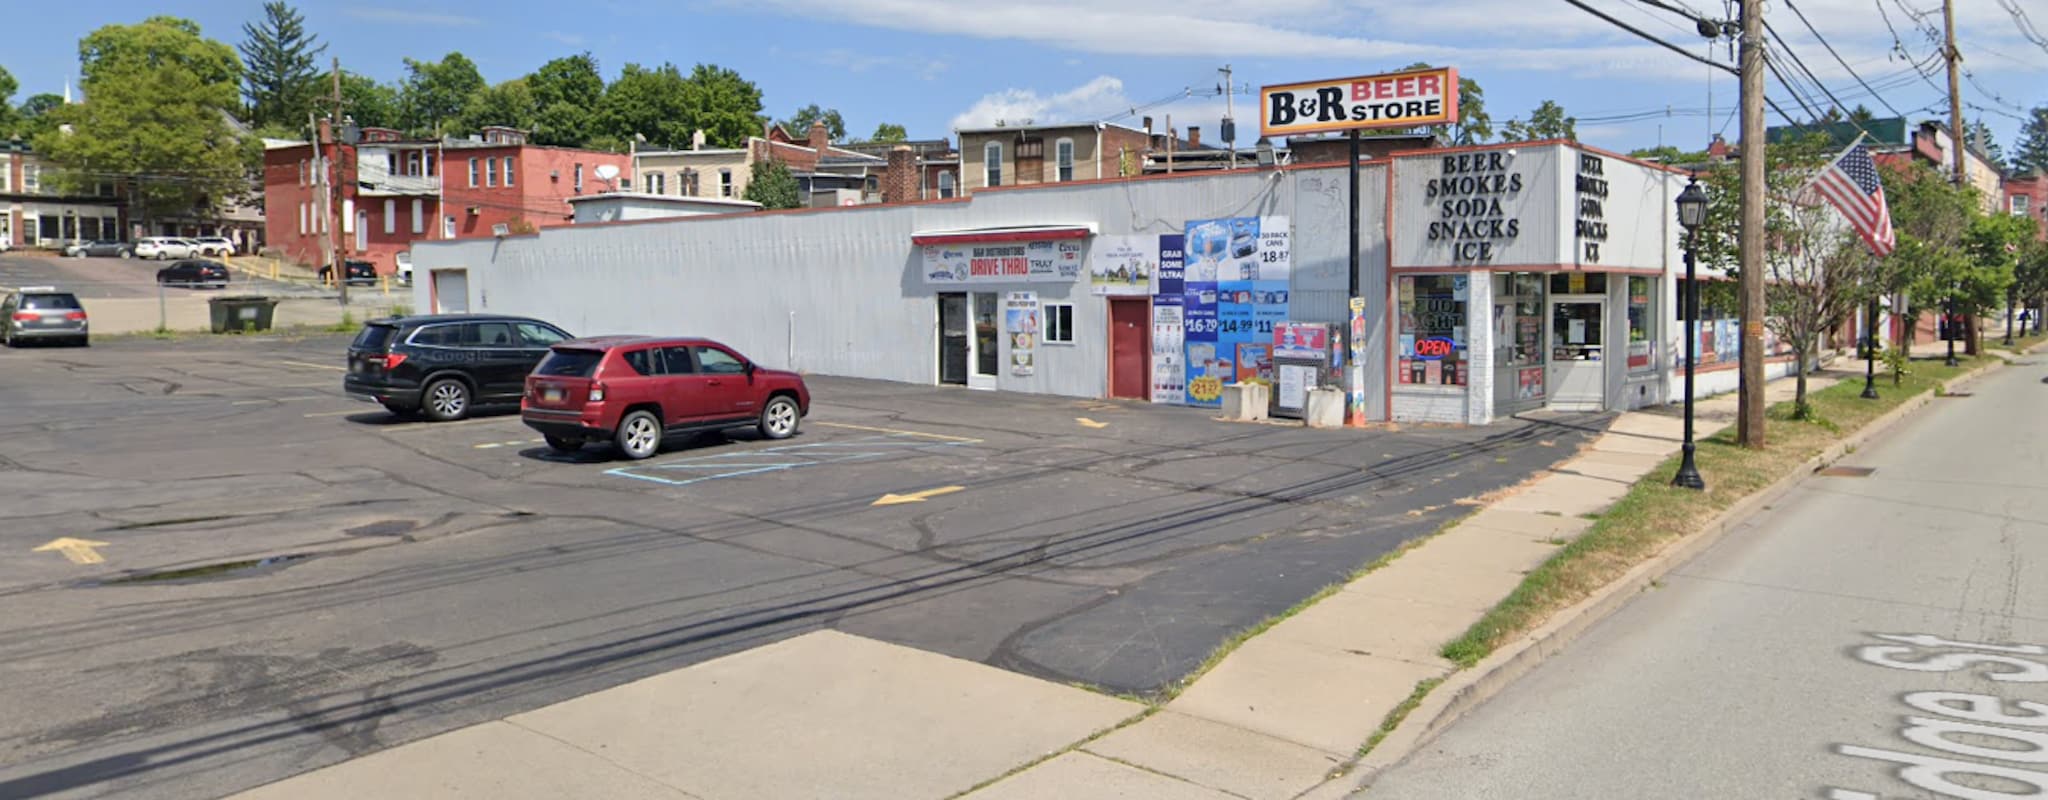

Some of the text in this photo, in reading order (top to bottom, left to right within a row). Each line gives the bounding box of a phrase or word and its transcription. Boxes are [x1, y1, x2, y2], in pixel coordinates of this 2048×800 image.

[1269, 75, 1440, 126] B&R BEER
[1351, 99, 1440, 121] STORE
[1443, 152, 1505, 175] BEER
[1581, 153, 1604, 176] BEER
[1426, 173, 1522, 198] SMOKES
[1576, 173, 1609, 201] SMOKES
[1442, 197, 1504, 219] SODA
[1580, 197, 1604, 219] SODA
[1428, 218, 1519, 241] SNACKS
[1576, 218, 1608, 242] SNACKS
[1162, 250, 1182, 258] GRAB
[1454, 241, 1493, 262] ICE
[1584, 242, 1600, 264] ICE
[970, 258, 999, 276] DRIVE
[1001, 257, 1028, 275] THRU
[1030, 260, 1053, 268] TRULY
[1161, 260, 1183, 269] SOME
[1415, 338, 1451, 356] OPEN
